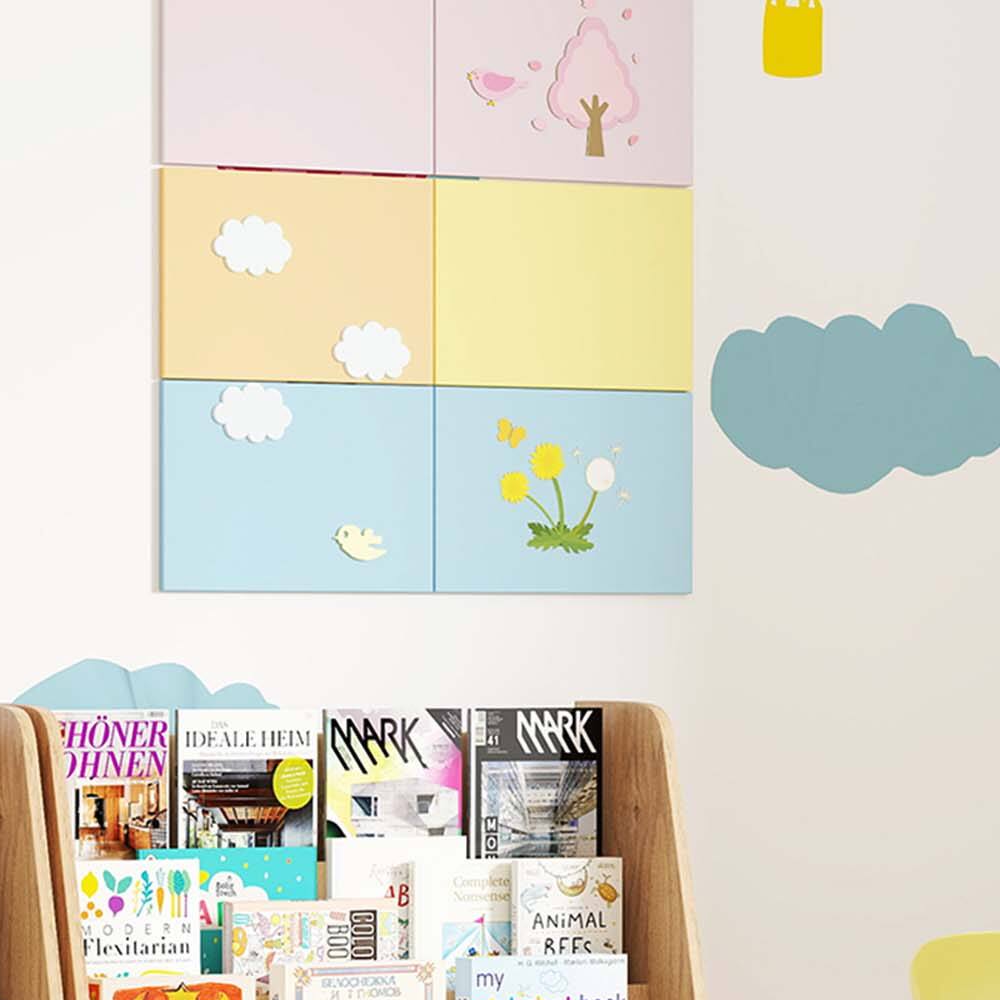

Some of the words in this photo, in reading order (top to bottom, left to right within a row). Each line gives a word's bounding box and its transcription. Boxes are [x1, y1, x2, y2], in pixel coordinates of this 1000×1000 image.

[185, 730, 257, 748] IDEALE
[261, 730, 311, 748] HEIM
[487, 735, 499, 746] 41
[516, 710, 597, 754] MARK
[331, 717, 428, 774] MARK
[486, 816, 499, 858] MO
[453, 876, 511, 891] Complete
[453, 891, 511, 902] Nonsense
[81, 922, 191, 936] MODERN
[350, 910, 376, 960] COLO
[82, 937, 190, 957] Flexitarian
[476, 972, 504, 992] my
